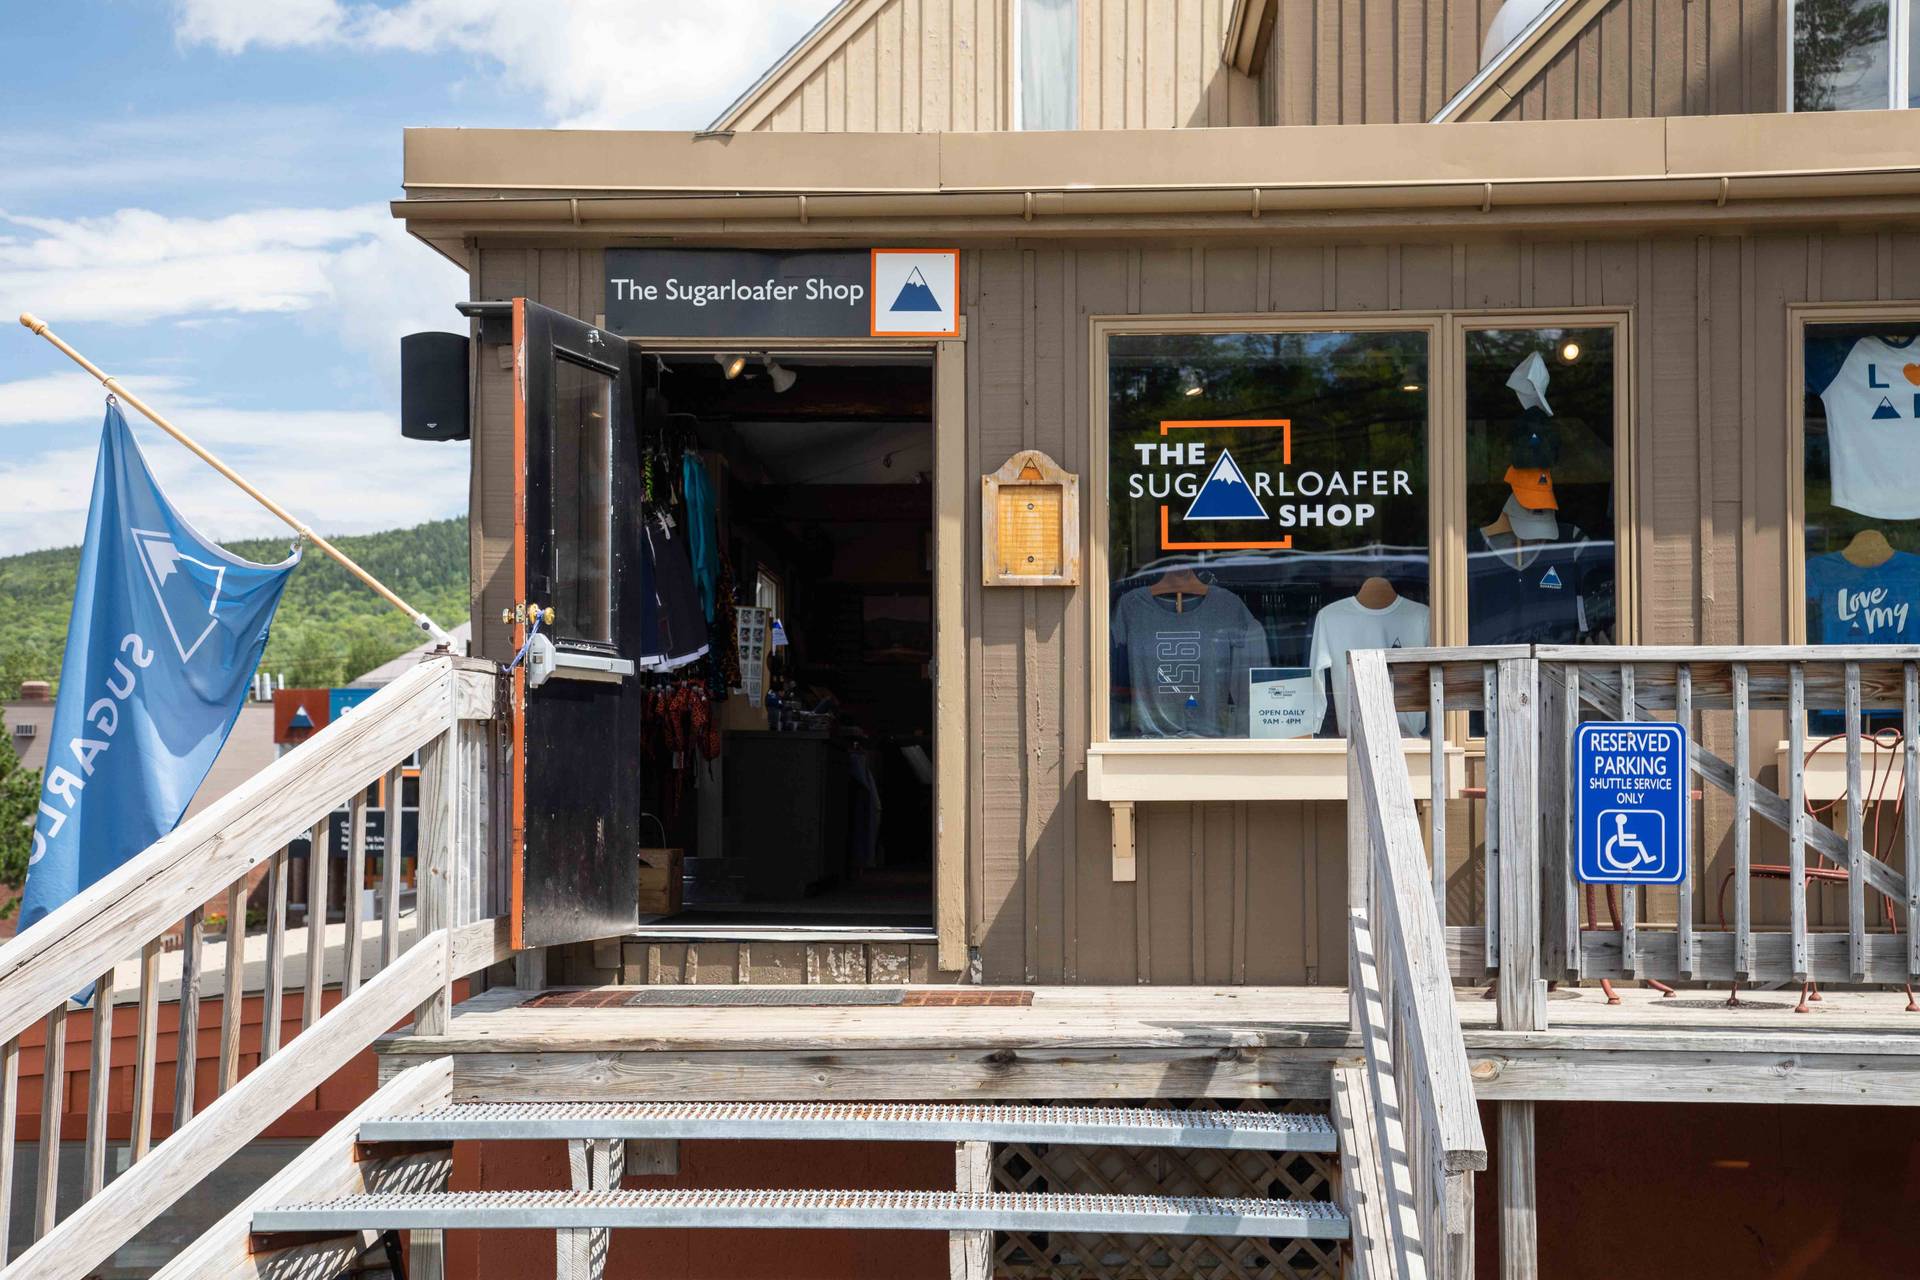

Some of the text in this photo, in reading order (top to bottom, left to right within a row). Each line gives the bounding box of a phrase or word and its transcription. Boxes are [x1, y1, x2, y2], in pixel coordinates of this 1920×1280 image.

[610, 278, 864, 307] The Sugarloafer Shop
[1134, 442, 1206, 466] THE
[1279, 503, 1376, 527] SHOP
[1838, 587, 1888, 621] Love
[1591, 732, 1671, 752] RESERVED
[1594, 756, 1667, 775] PARKING
[1589, 778, 1672, 790] SHUTTLE SERVICE
[1616, 792, 1645, 804] ONLY
